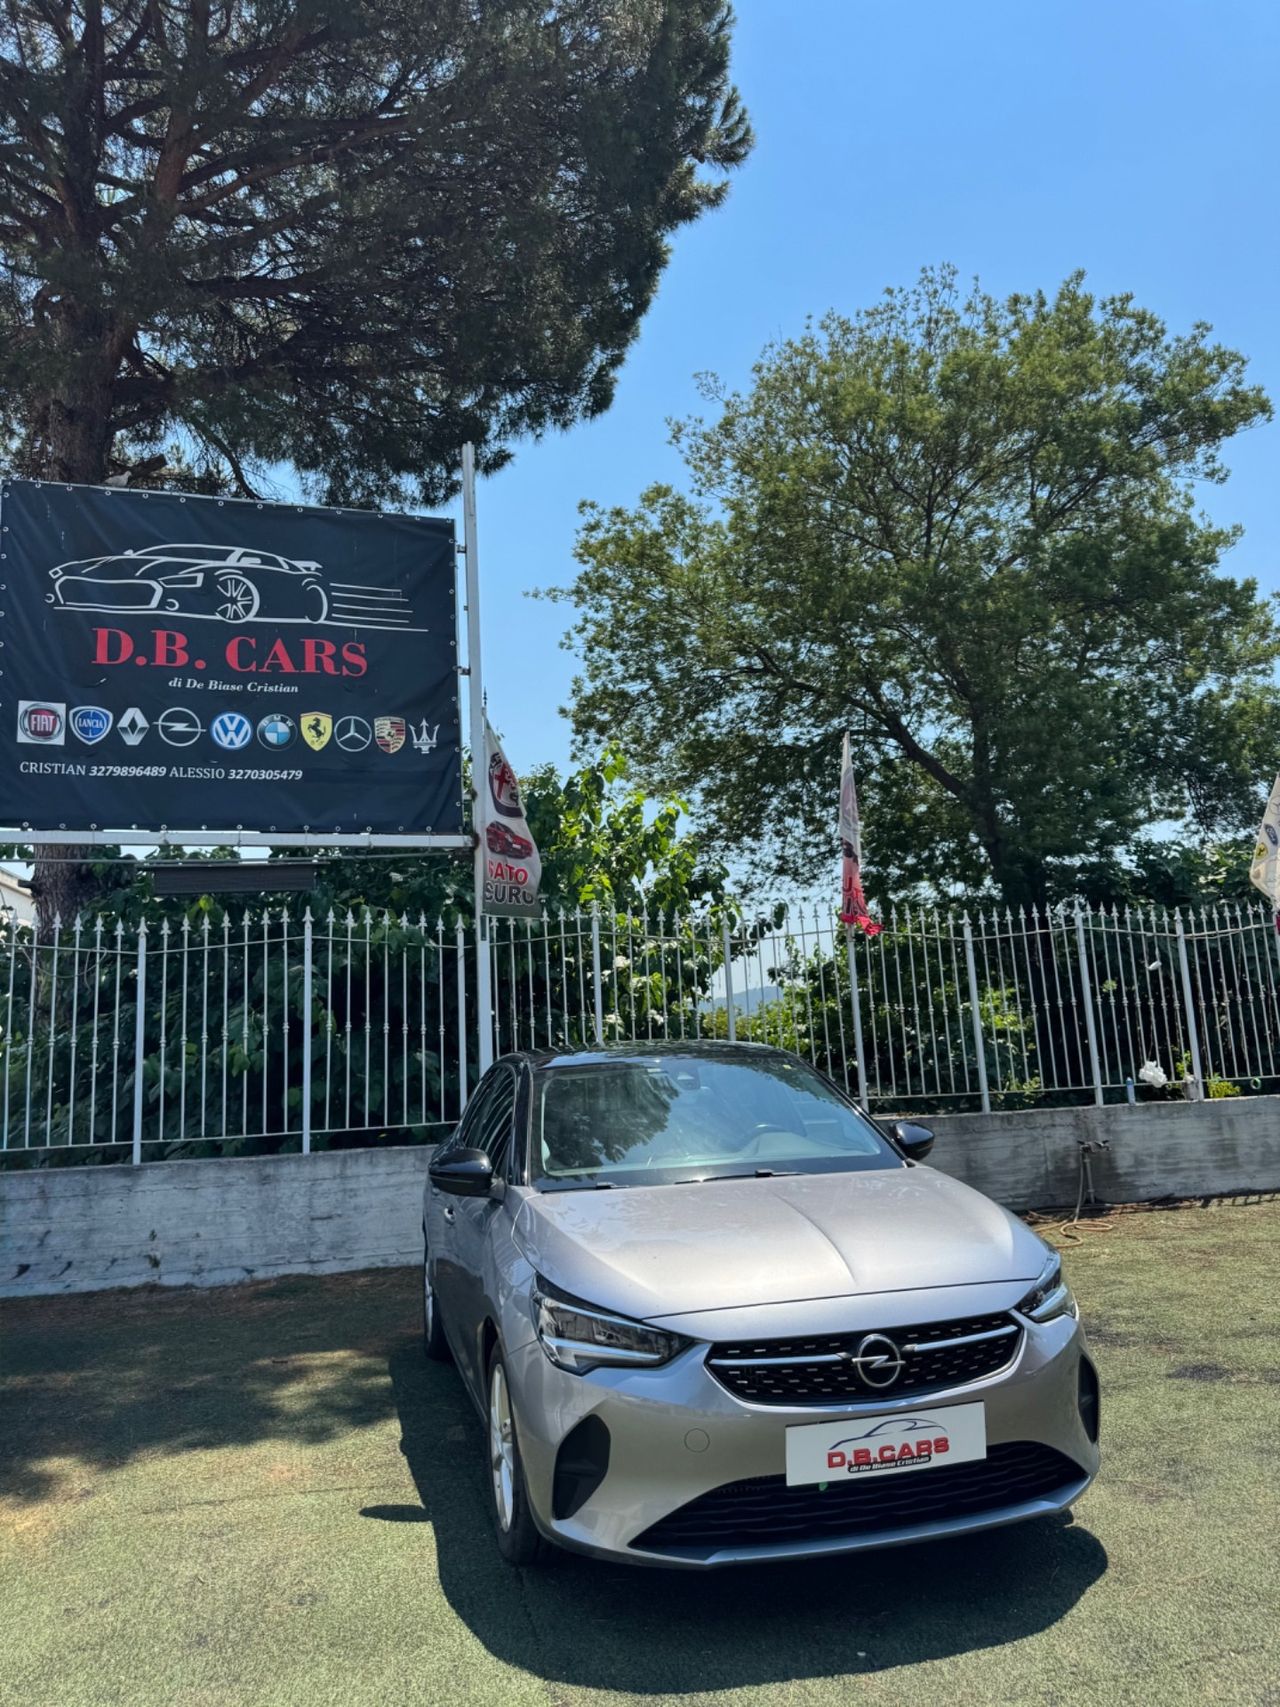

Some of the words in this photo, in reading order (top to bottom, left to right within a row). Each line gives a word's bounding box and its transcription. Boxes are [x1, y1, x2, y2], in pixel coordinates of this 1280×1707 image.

[91, 627, 207, 670] D.B.
[225, 636, 368, 677] CARS
[168, 677, 182, 688] di
[185, 678, 204, 689] De
[247, 681, 299, 693] Cristian
[30, 714, 56, 732] FIAT
[79, 717, 104, 729] LANCIA
[19, 761, 86, 776] CRISTIAN
[88, 765, 167, 777] 3279896489
[169, 766, 225, 779] ALESSIO
[227, 769, 303, 780] 3270305479
